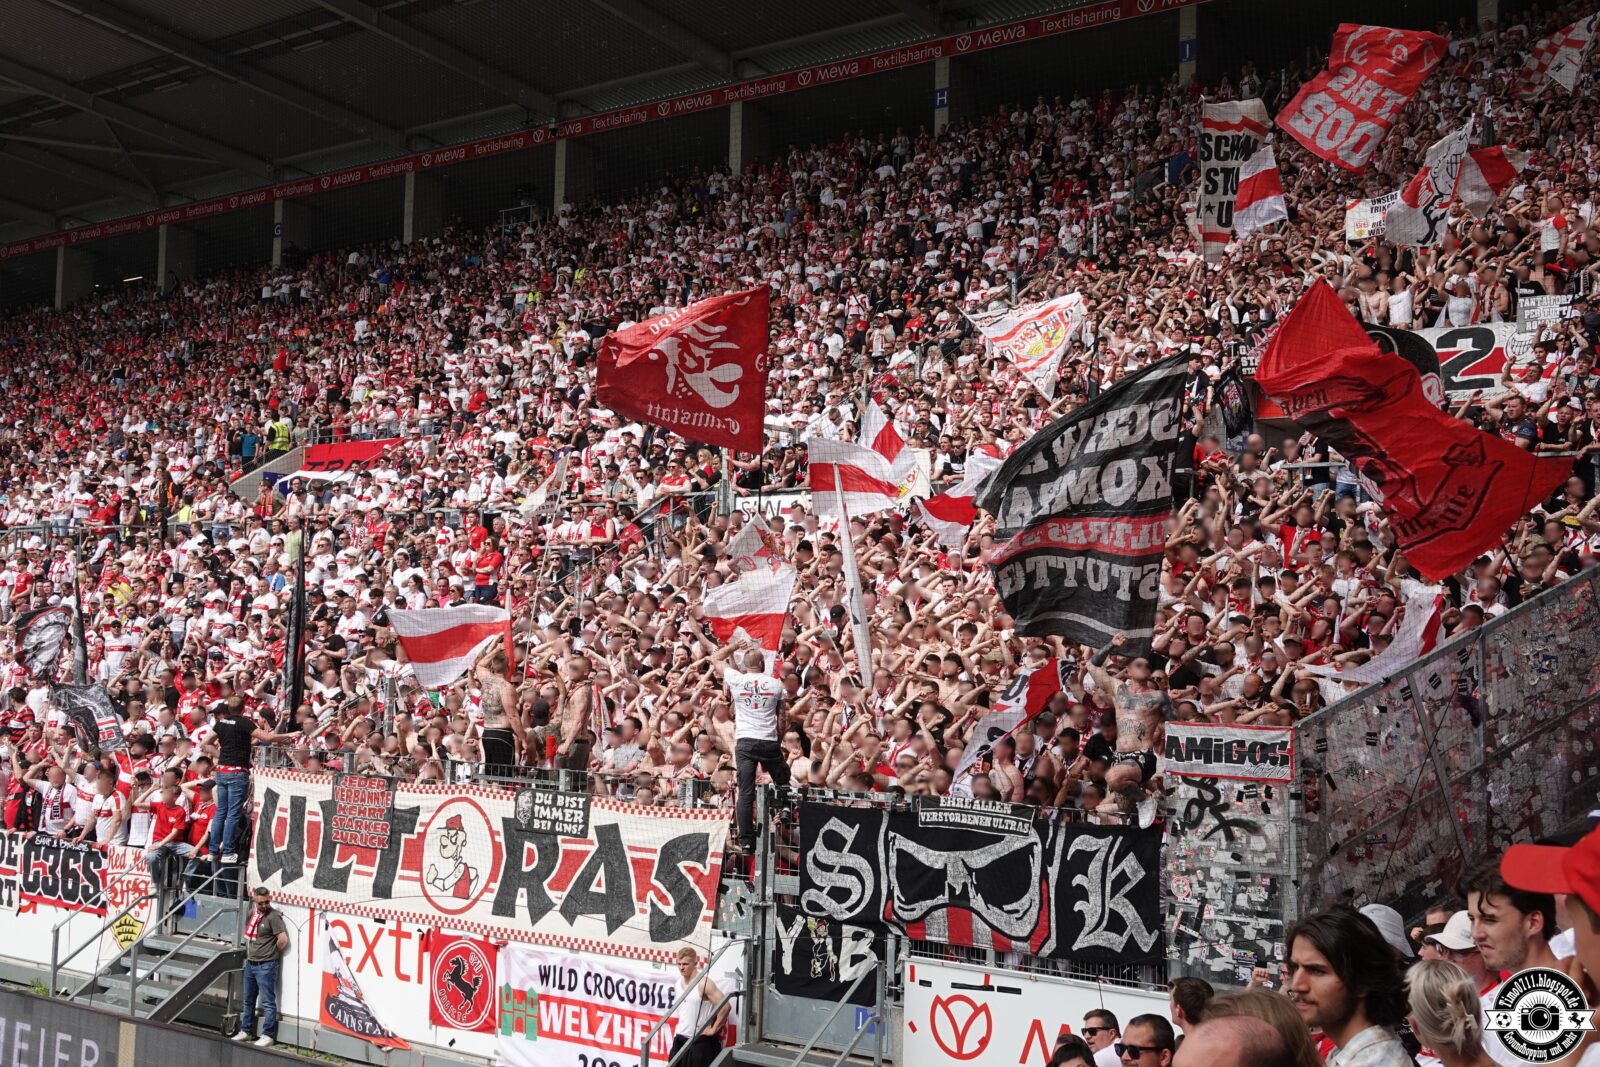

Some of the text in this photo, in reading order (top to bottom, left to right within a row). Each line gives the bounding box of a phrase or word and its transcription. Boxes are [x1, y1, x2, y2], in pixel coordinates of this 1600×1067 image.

[368, 159, 413, 179] Textilsharing
[475, 136, 524, 156] Textilsharing
[591, 107, 647, 130] Textilsharing
[723, 79, 786, 103] Textilsharing
[871, 46, 942, 71] Textilsharing
[1039, 7, 1121, 34] Textilsharing
[937, 91, 947, 106] H
[274, 224, 281, 237] G
[1551, 295, 1573, 305] FORZ
[341, 775, 388, 791] JEDER
[334, 785, 393, 808] VERBANNTE
[534, 792, 586, 808] DU BIST
[939, 796, 1012, 814] EHRE ALLEN
[337, 803, 386, 820] KEHRT
[534, 806, 584, 823] IMMER
[533, 818, 585, 835] BEI UNS!
[920, 811, 1030, 837] VERSTORBENEN ULTRAS
[538, 964, 676, 1010] WILD CROCODILE
